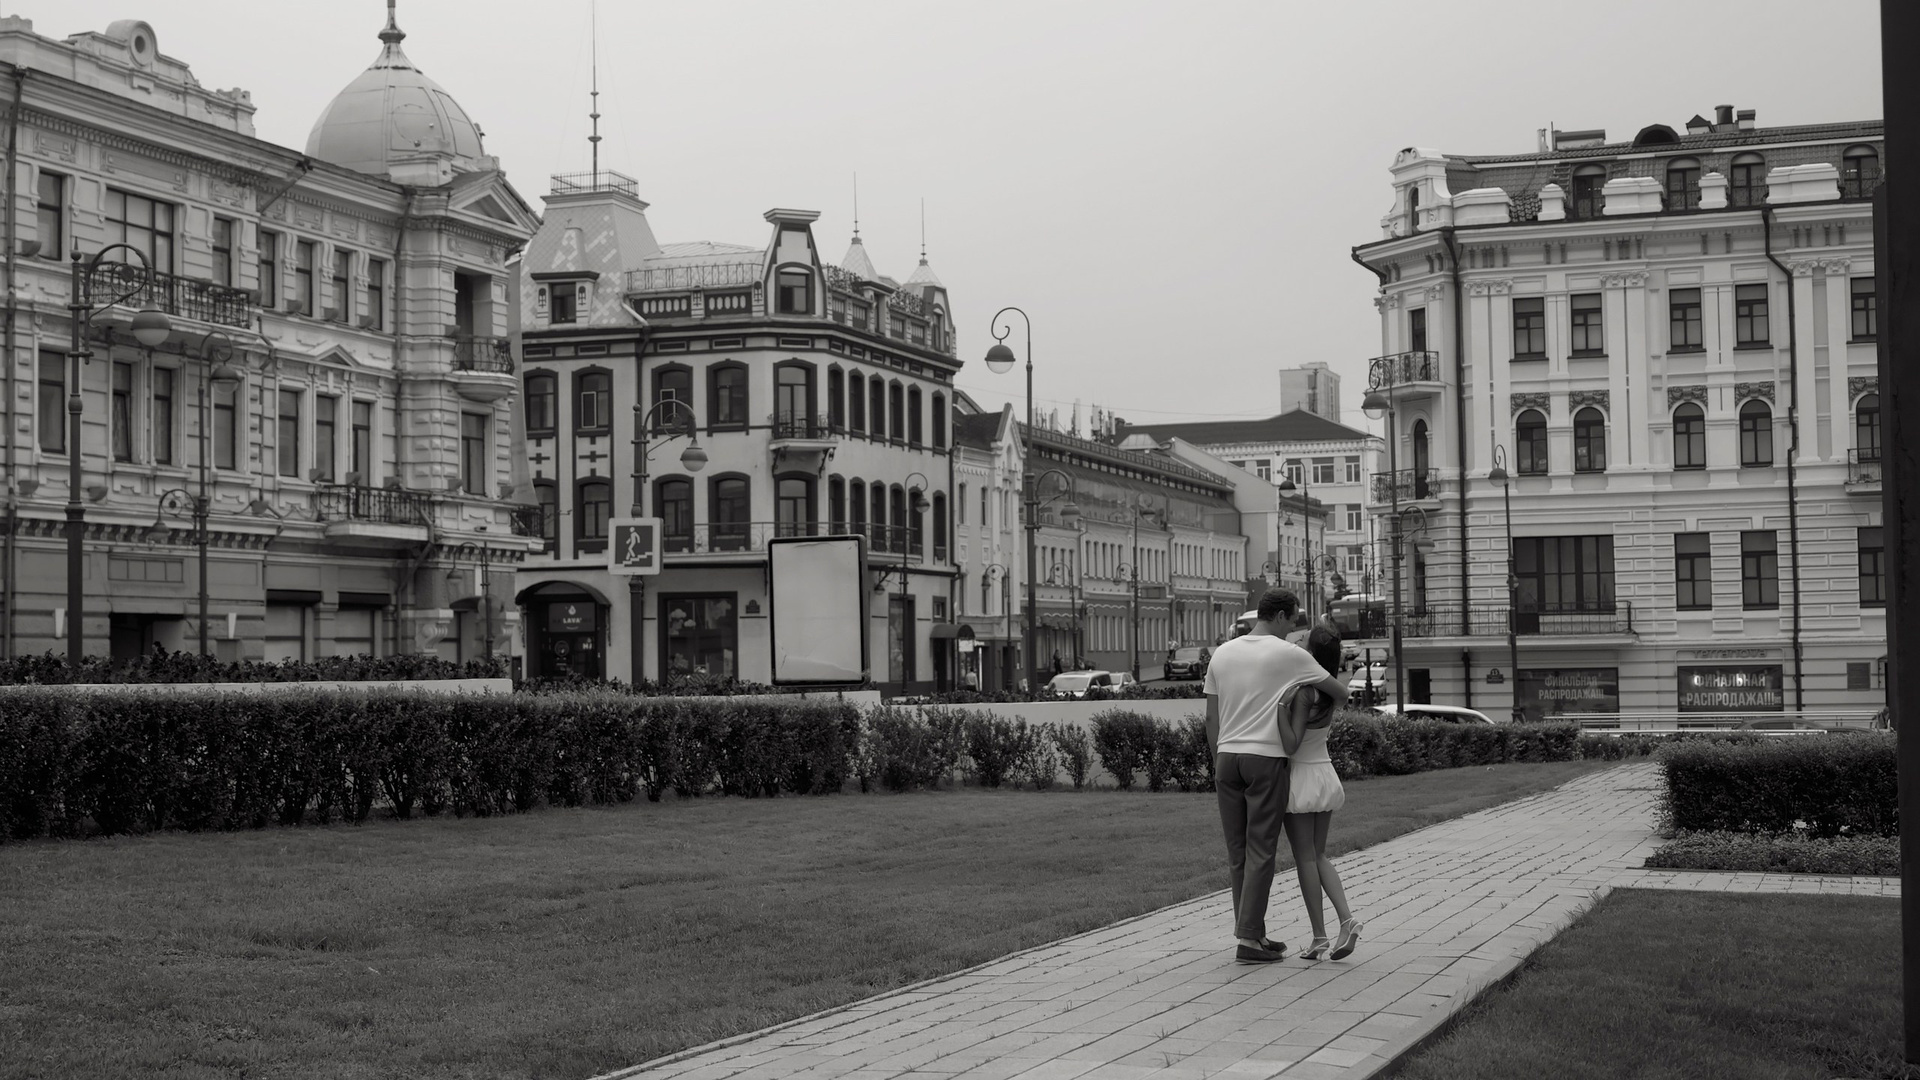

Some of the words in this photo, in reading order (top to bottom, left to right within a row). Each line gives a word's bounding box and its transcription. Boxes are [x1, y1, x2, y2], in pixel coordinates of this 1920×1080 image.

[1545, 675, 1598, 687] ФИНАЛЬНАЯ
[1694, 674, 1766, 688] ФИНАЛЬНАЯ
[1687, 692, 1774, 708] РАСПРОДАЖА!!!
